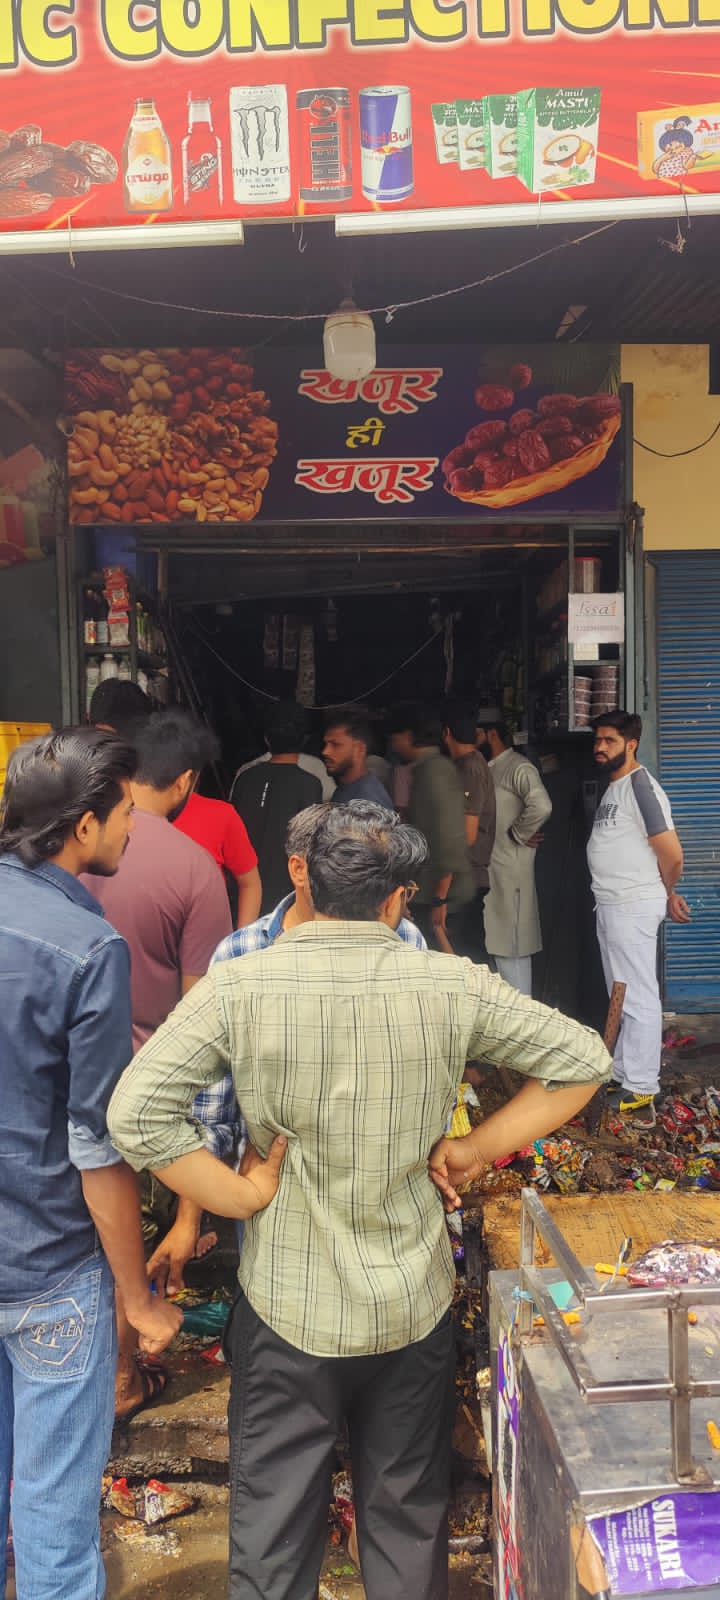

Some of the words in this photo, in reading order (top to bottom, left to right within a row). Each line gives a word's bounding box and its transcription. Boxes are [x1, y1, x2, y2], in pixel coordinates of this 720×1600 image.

[546, 97, 588, 109] MASTI
[556, 88, 583, 97] Amul
[309, 120, 341, 180] HELL
[298, 368, 443, 414] खजूर
[345, 417, 386, 448] ही
[295, 457, 439, 503] खजूर
[651, 1499, 684, 1580] SUKARI
